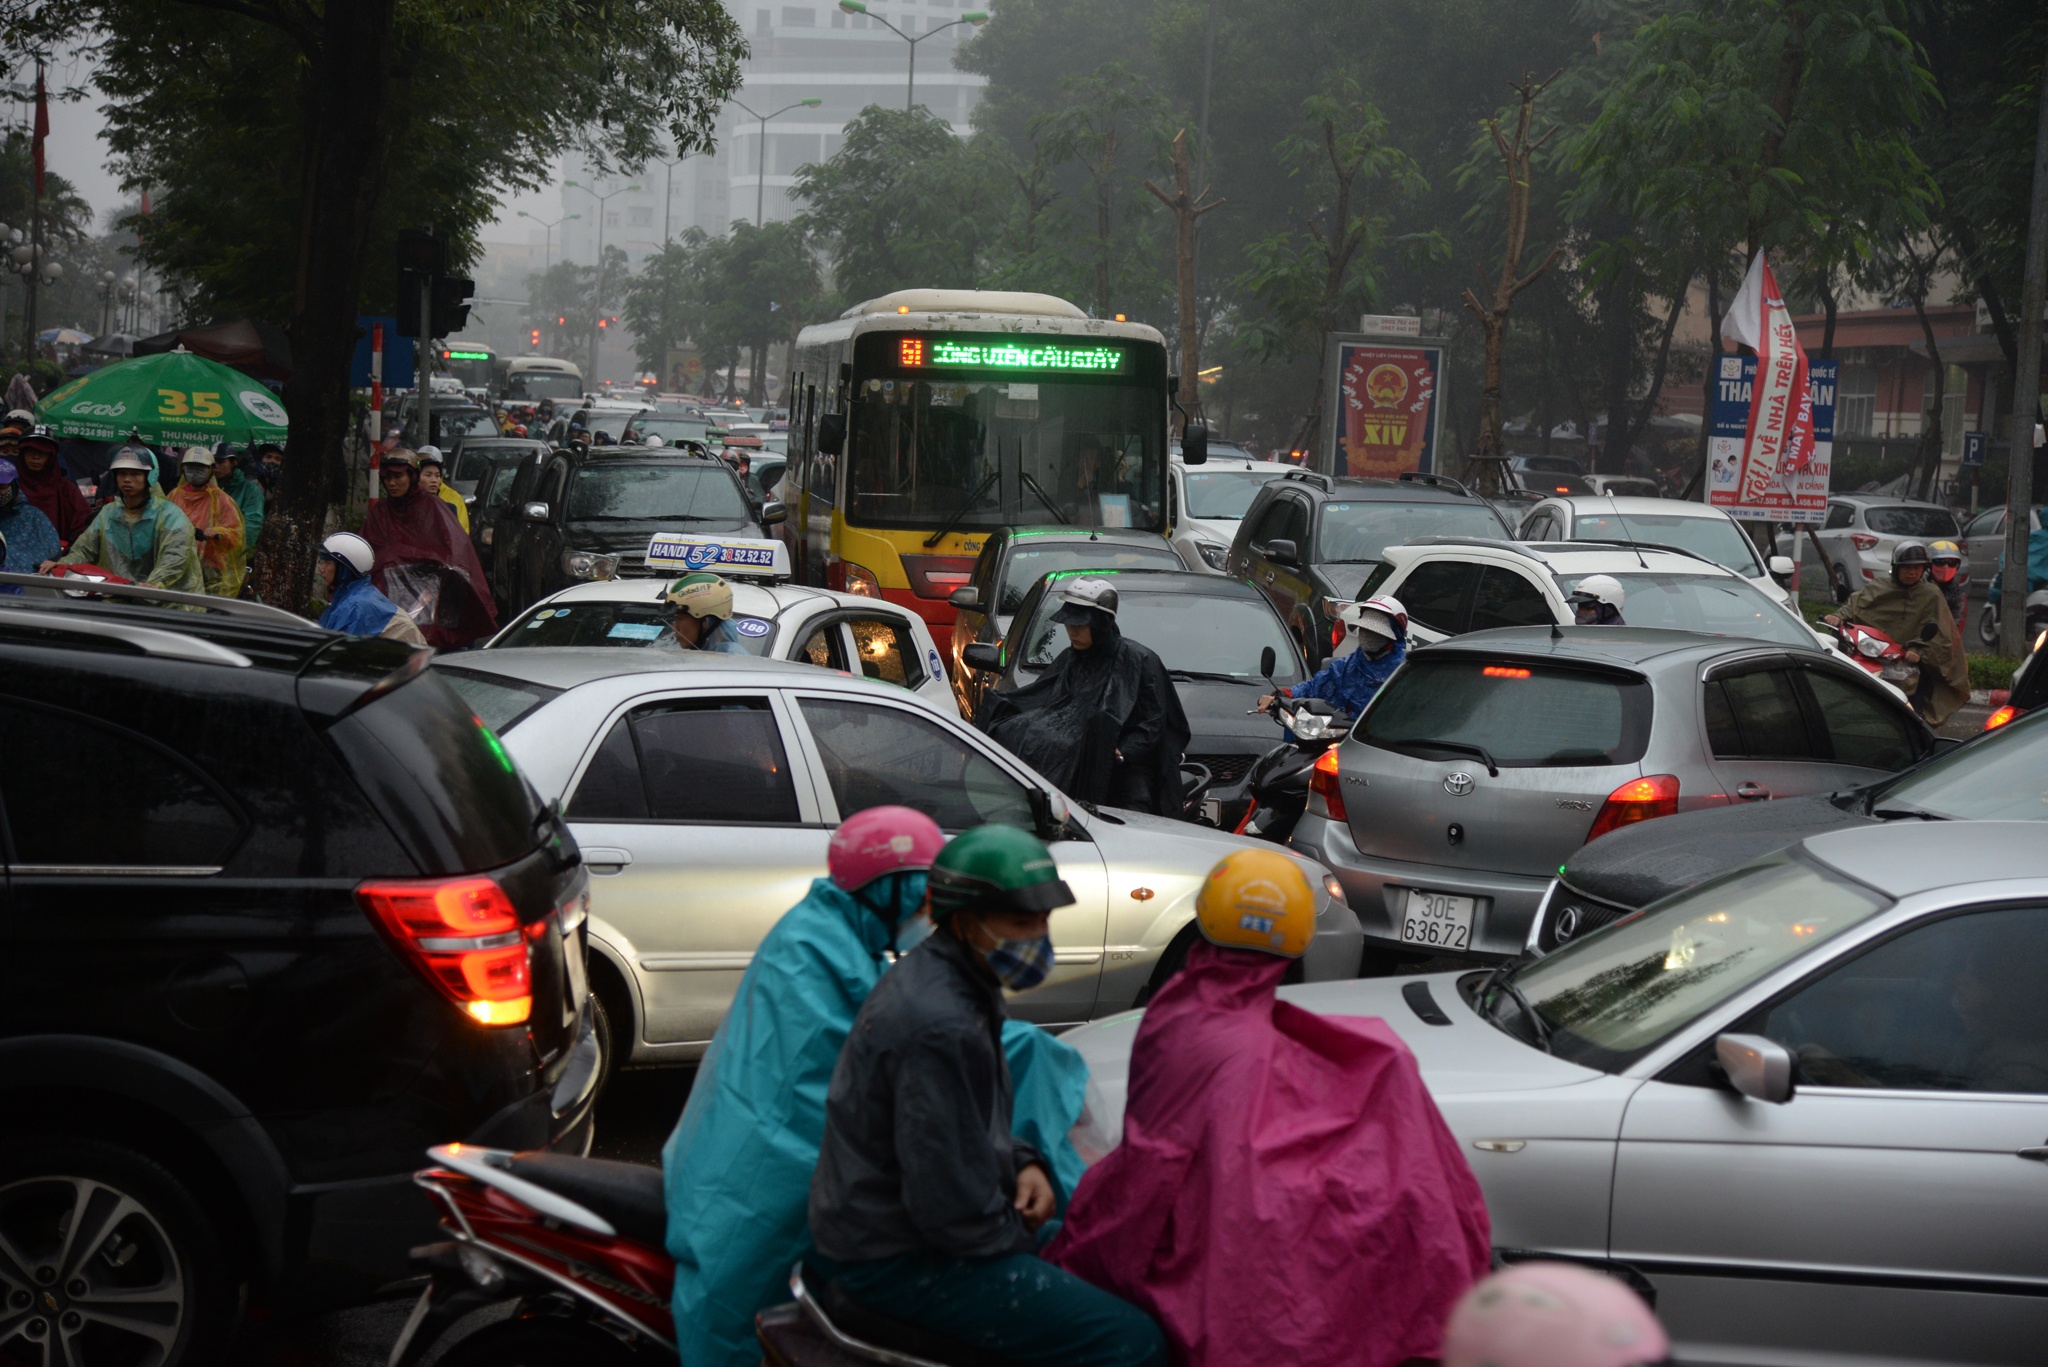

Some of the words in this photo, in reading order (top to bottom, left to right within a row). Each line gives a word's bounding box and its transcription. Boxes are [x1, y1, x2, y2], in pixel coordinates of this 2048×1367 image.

[1775, 351, 1793, 388] TRÊN
[158, 389, 223, 418] 35
[1719, 381, 1752, 402] THA
[1810, 381, 1834, 406] ÂN
[71, 401, 126, 417] Grab
[1767, 395, 1786, 431] NHÀ
[63, 426, 79, 435] 090
[80, 428, 95, 437] 234
[96, 429, 114, 438] 9811
[161, 430, 180, 440] THU
[182, 431, 209, 442] NHẬP
[1363, 424, 1407, 446] XIV
[1970, 438, 1978, 458] P
[652, 543, 689, 558] HANOI
[688, 546, 719, 564] 52
[720, 548, 772, 564] 38.52.52.52
[964, 539, 981, 551] CÔNG
[741, 622, 765, 633] 168
[1555, 799, 1593, 812] YARIS
[1421, 896, 1459, 921] 30E
[1404, 918, 1468, 949] 636.72
